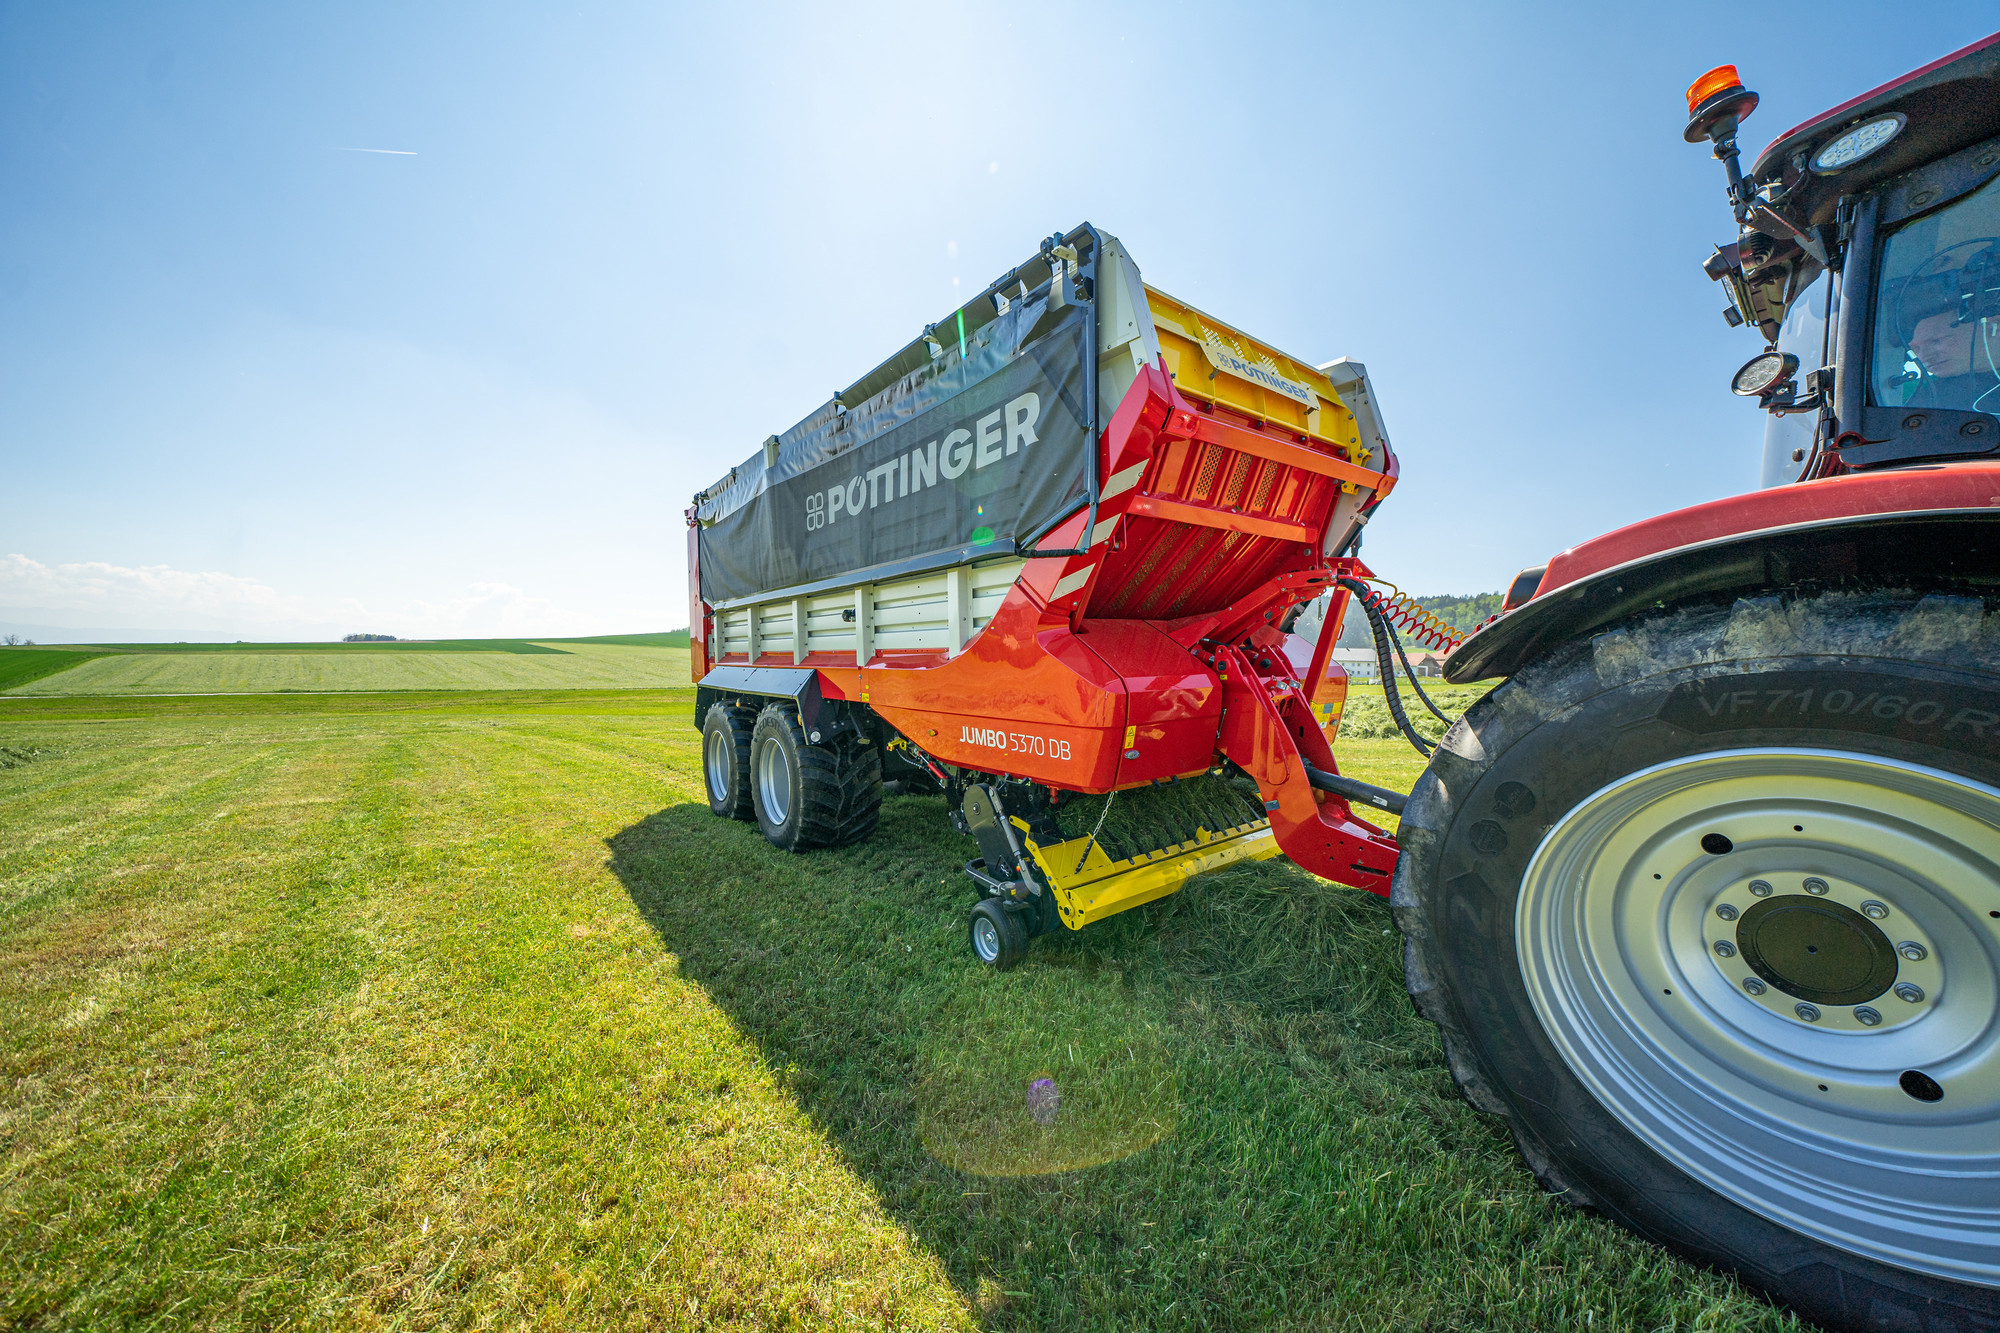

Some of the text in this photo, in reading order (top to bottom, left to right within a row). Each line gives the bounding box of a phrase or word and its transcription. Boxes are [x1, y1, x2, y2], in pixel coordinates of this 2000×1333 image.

[827, 391, 1041, 525] PÖTTINGER
[1943, 707, 2000, 738] R
[959, 725, 1072, 761] JUMBO 5370 DB
